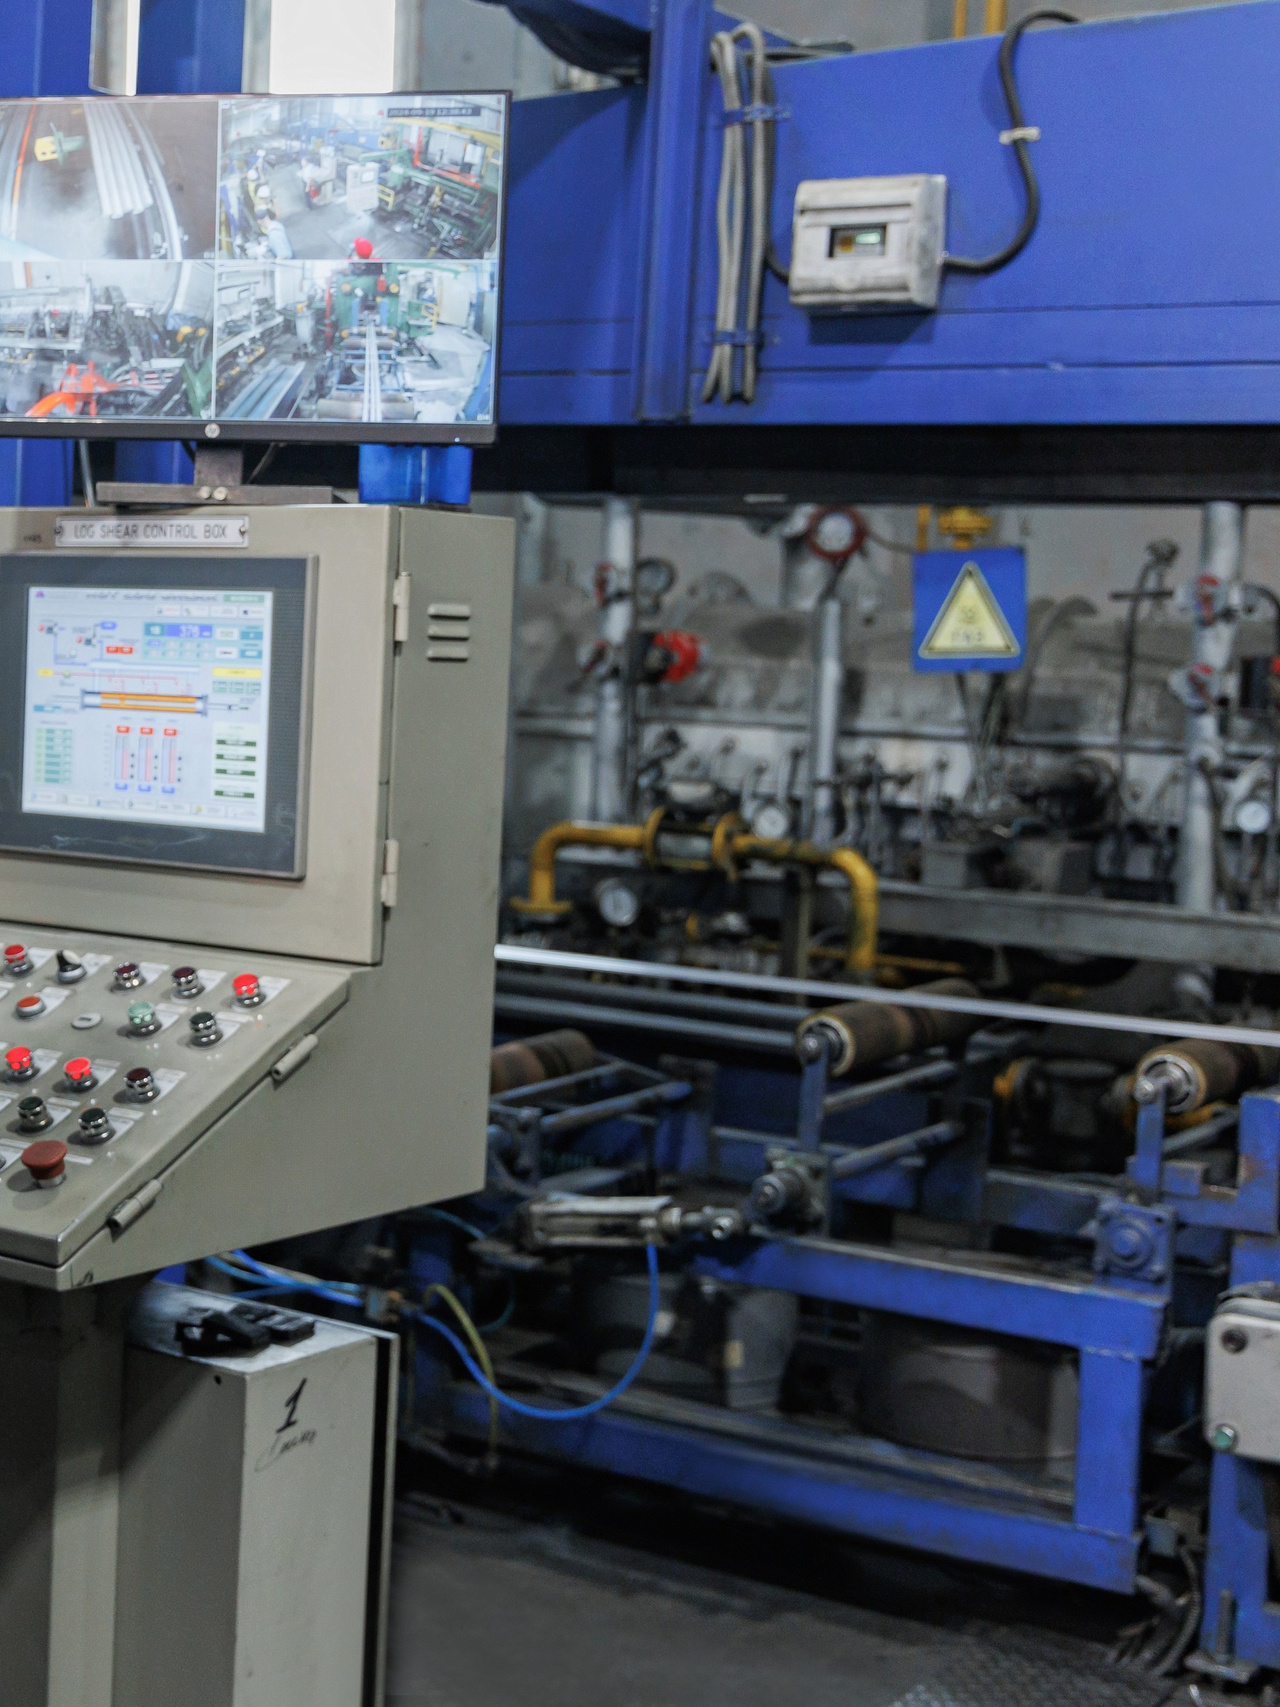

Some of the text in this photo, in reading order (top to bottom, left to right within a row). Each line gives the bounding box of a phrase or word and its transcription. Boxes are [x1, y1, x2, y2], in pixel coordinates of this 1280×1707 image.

[74, 523, 227, 539] LOG SHEAR CONTROL BOX
[275, 1377, 308, 1433] 1
